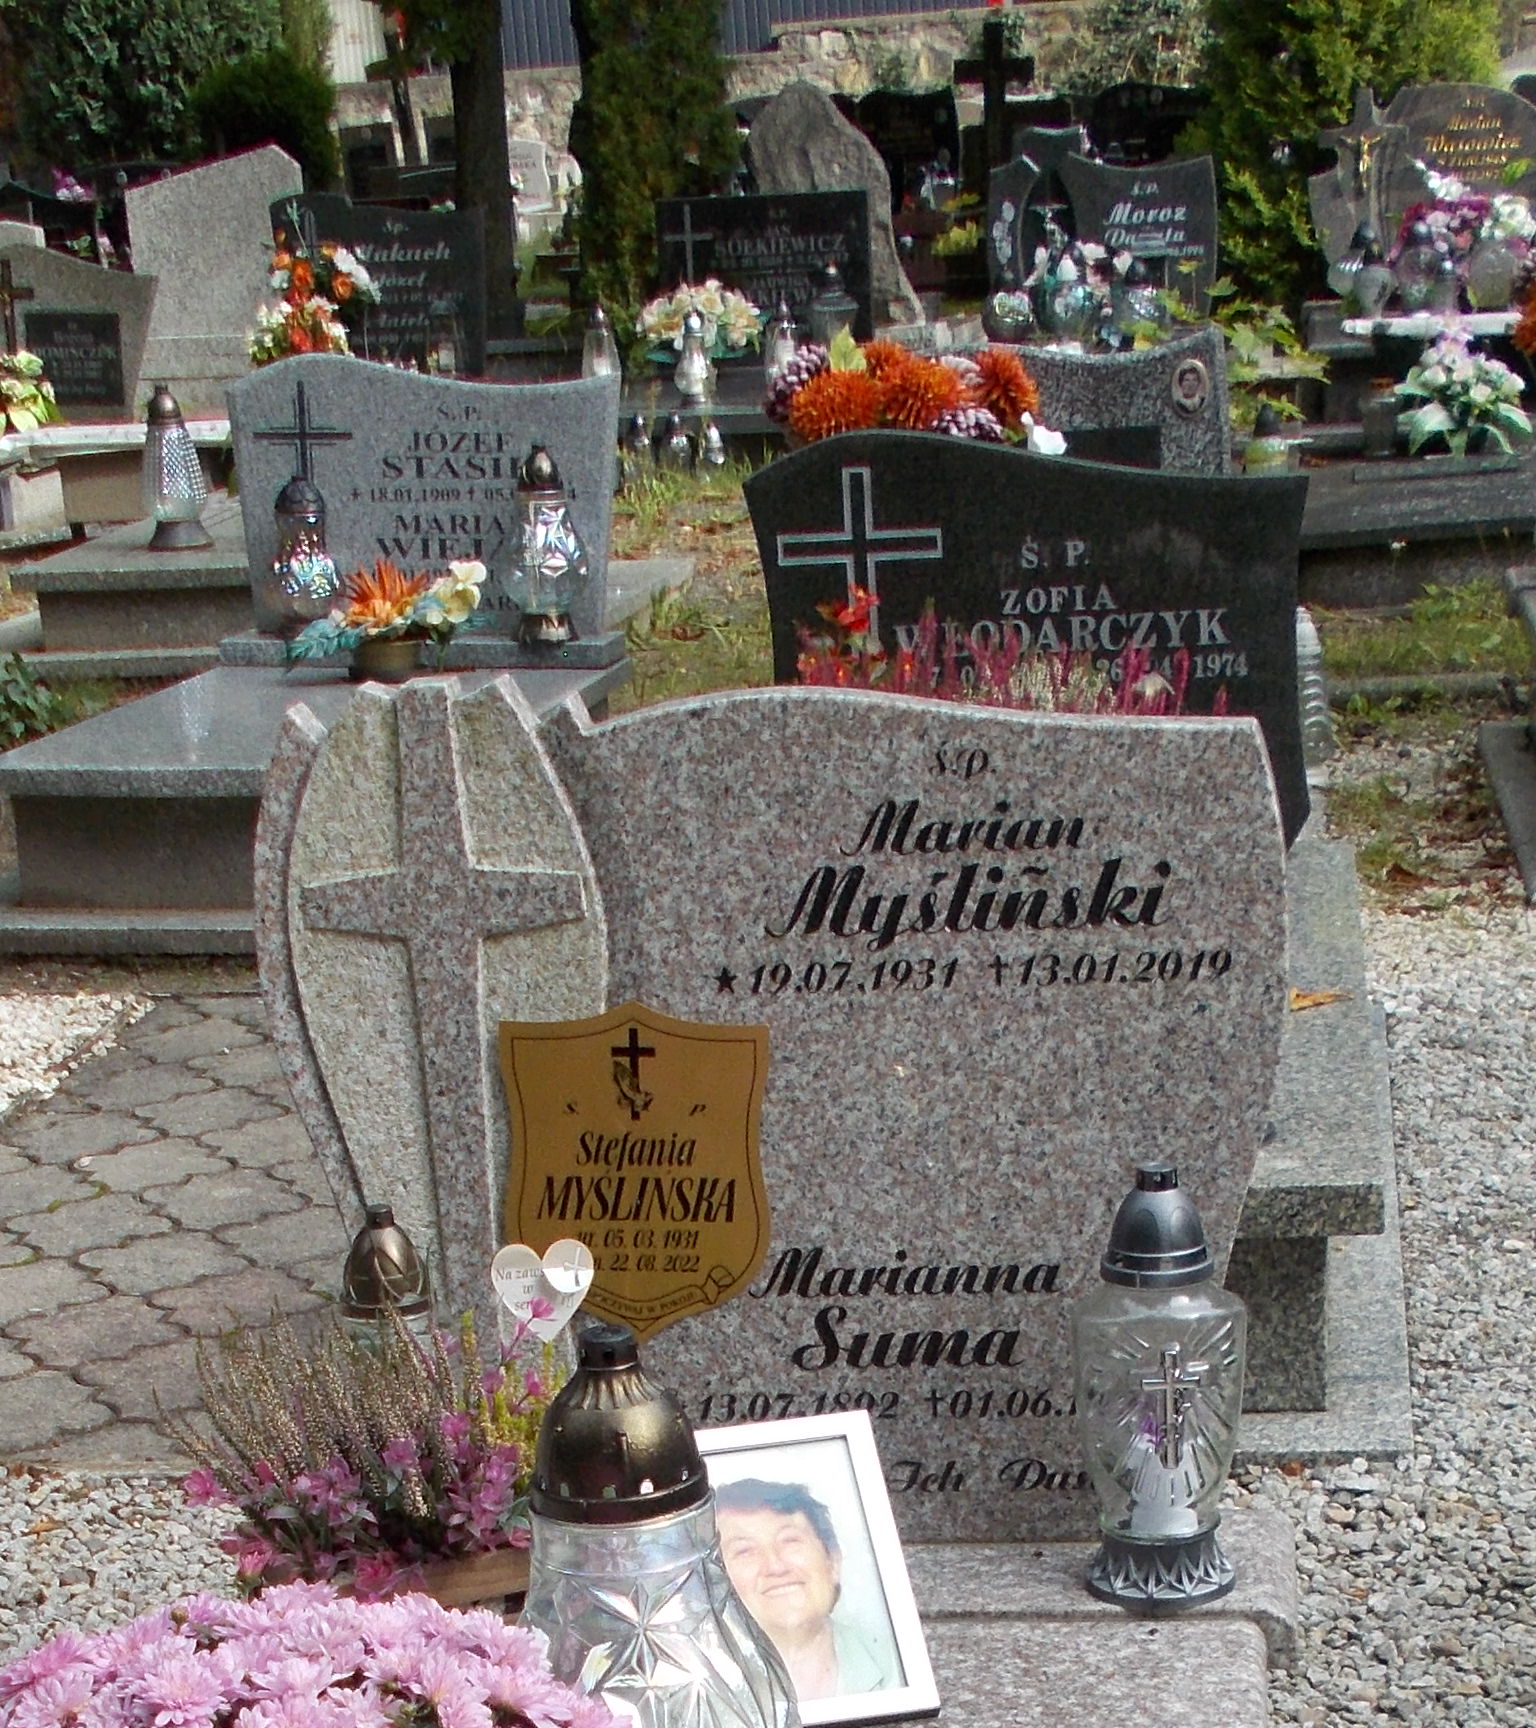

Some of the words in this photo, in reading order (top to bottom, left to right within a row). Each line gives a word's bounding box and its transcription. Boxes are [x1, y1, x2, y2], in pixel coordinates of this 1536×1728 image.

[1103, 202, 1187, 225] Moroz
[407, 423, 514, 453] JÓZEF
[1000, 583, 1120, 616] ZOFIA
[1192, 651, 1251, 681] 1974
[838, 798, 1086, 858] Marian
[749, 956, 960, 996] 19.07.1931
[1017, 948, 1234, 989] 13.01.2019
[576, 1130, 697, 1172] Stefania
[536, 1168, 737, 1224] MYŚLIŃSKA
[663, 1229, 701, 1250] 1931
[609, 1254, 631, 1273] 22.
[663, 1254, 701, 1274] 2022
[746, 1248, 1063, 1300] Marianna
[790, 1304, 1027, 1372] Suma
